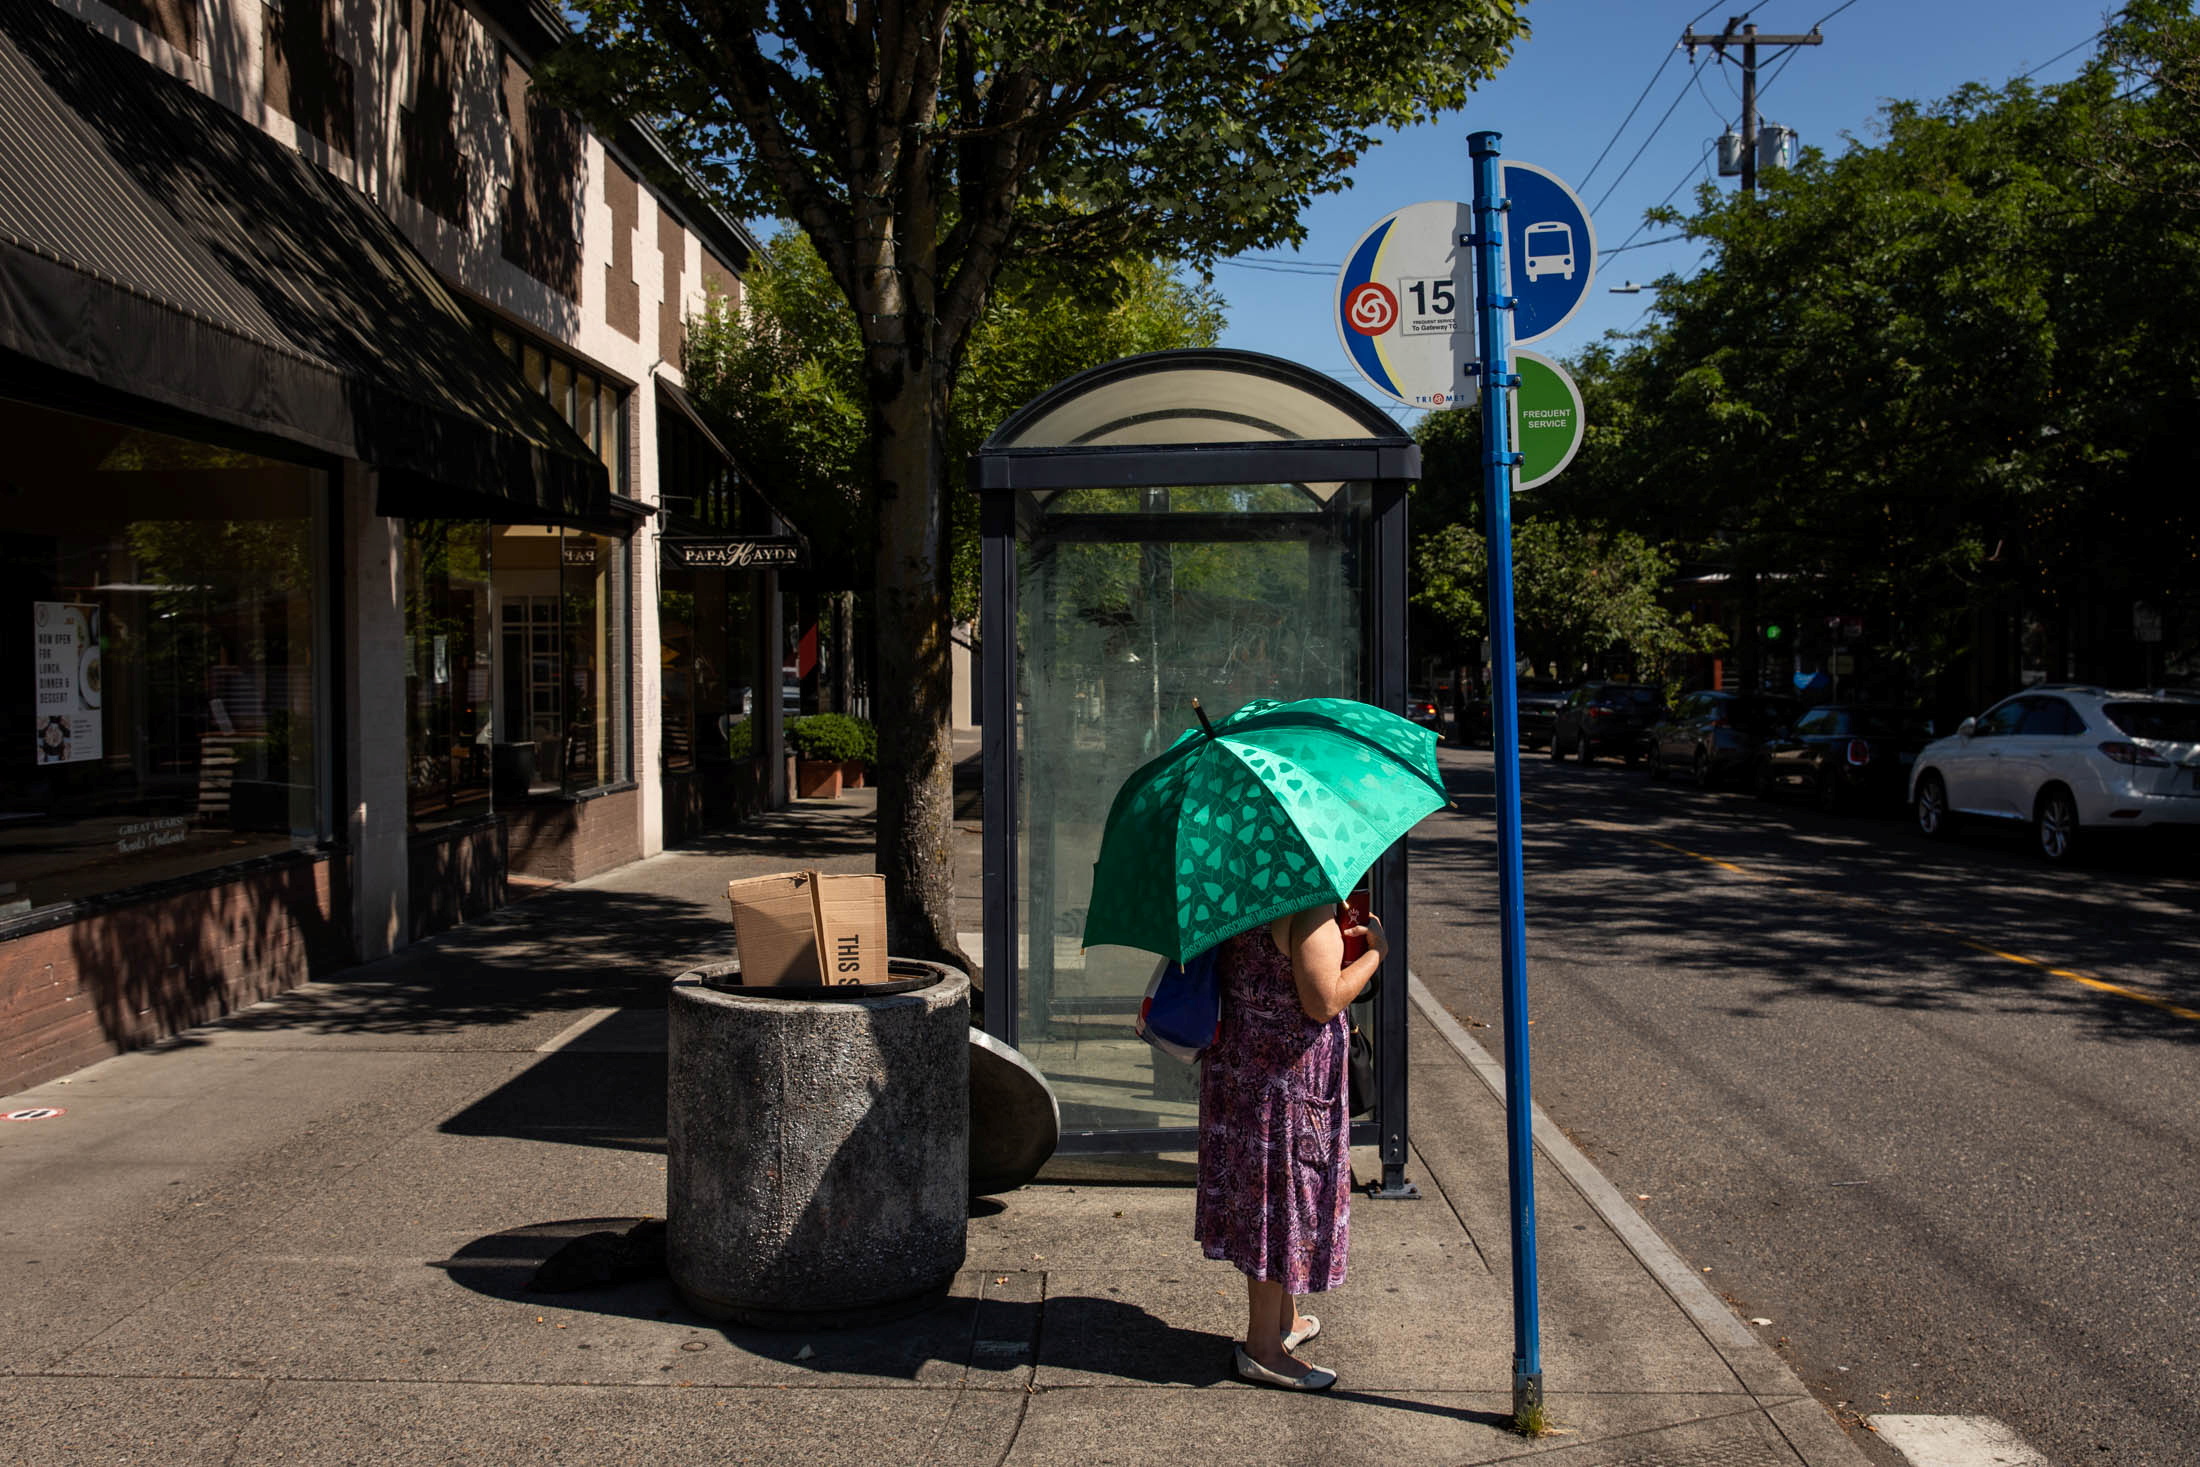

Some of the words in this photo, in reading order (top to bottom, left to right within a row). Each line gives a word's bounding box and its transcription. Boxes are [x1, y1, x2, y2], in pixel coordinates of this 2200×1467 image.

[1409, 280, 1455, 315] 15
[1522, 408, 1571, 418] FREQUENT
[1528, 419, 1567, 428] SERVICE
[685, 550, 727, 561] PAPA
[720, 542, 798, 566] HAYDN
[56, 633, 72, 645] OPEN
[39, 648, 51, 659] FOR
[40, 678, 64, 689] DINNER
[40, 692, 68, 704] DESSERT
[1216, 915, 1256, 938] MOSCHINO
[1256, 903, 1298, 922] MOSCHINO
[838, 934, 860, 972] THIS
